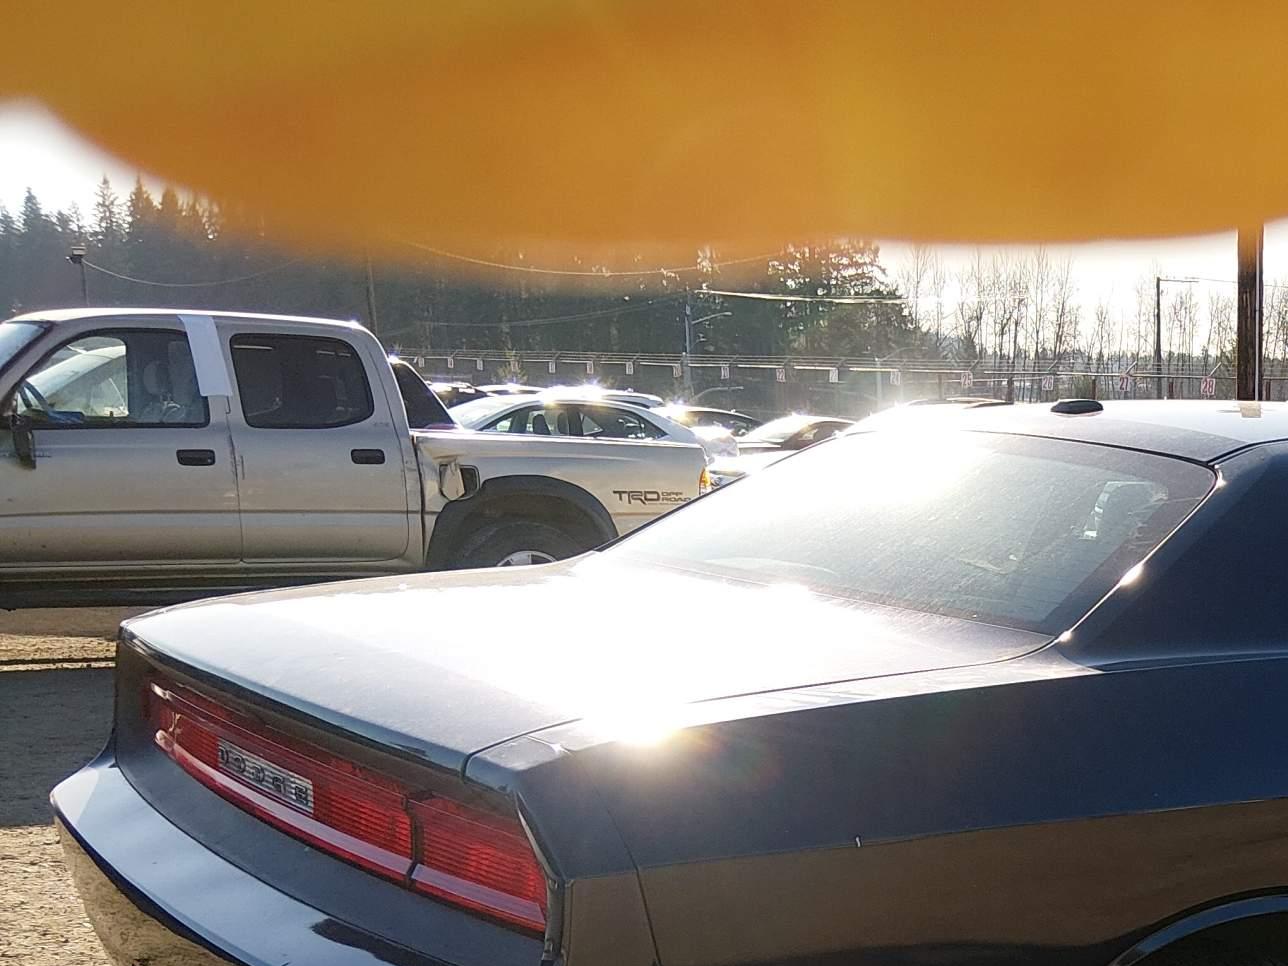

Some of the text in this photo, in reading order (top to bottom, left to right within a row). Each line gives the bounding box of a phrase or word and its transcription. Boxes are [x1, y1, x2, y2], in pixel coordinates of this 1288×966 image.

[1119, 376, 1129, 391] 27
[1202, 379, 1214, 394] 28
[613, 490, 660, 505] TRD
